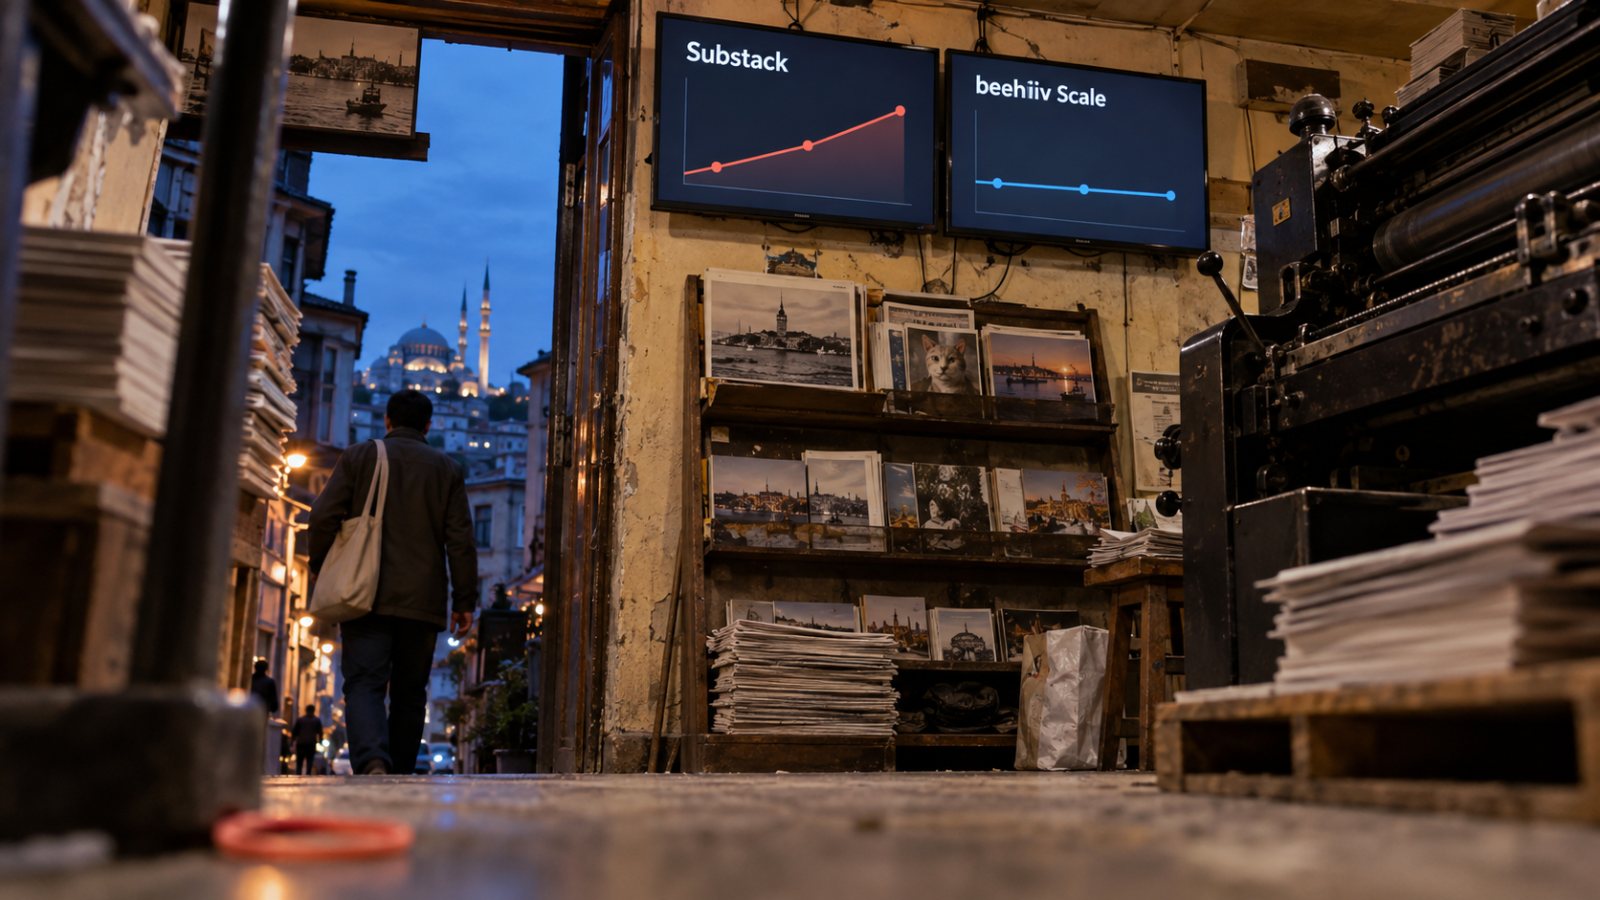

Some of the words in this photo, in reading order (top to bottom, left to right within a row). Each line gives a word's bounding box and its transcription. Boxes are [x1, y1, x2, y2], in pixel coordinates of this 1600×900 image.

[686, 40, 788, 73] Substack
[975, 74, 1052, 101] beehiiv
[1057, 84, 1107, 108] Scale
